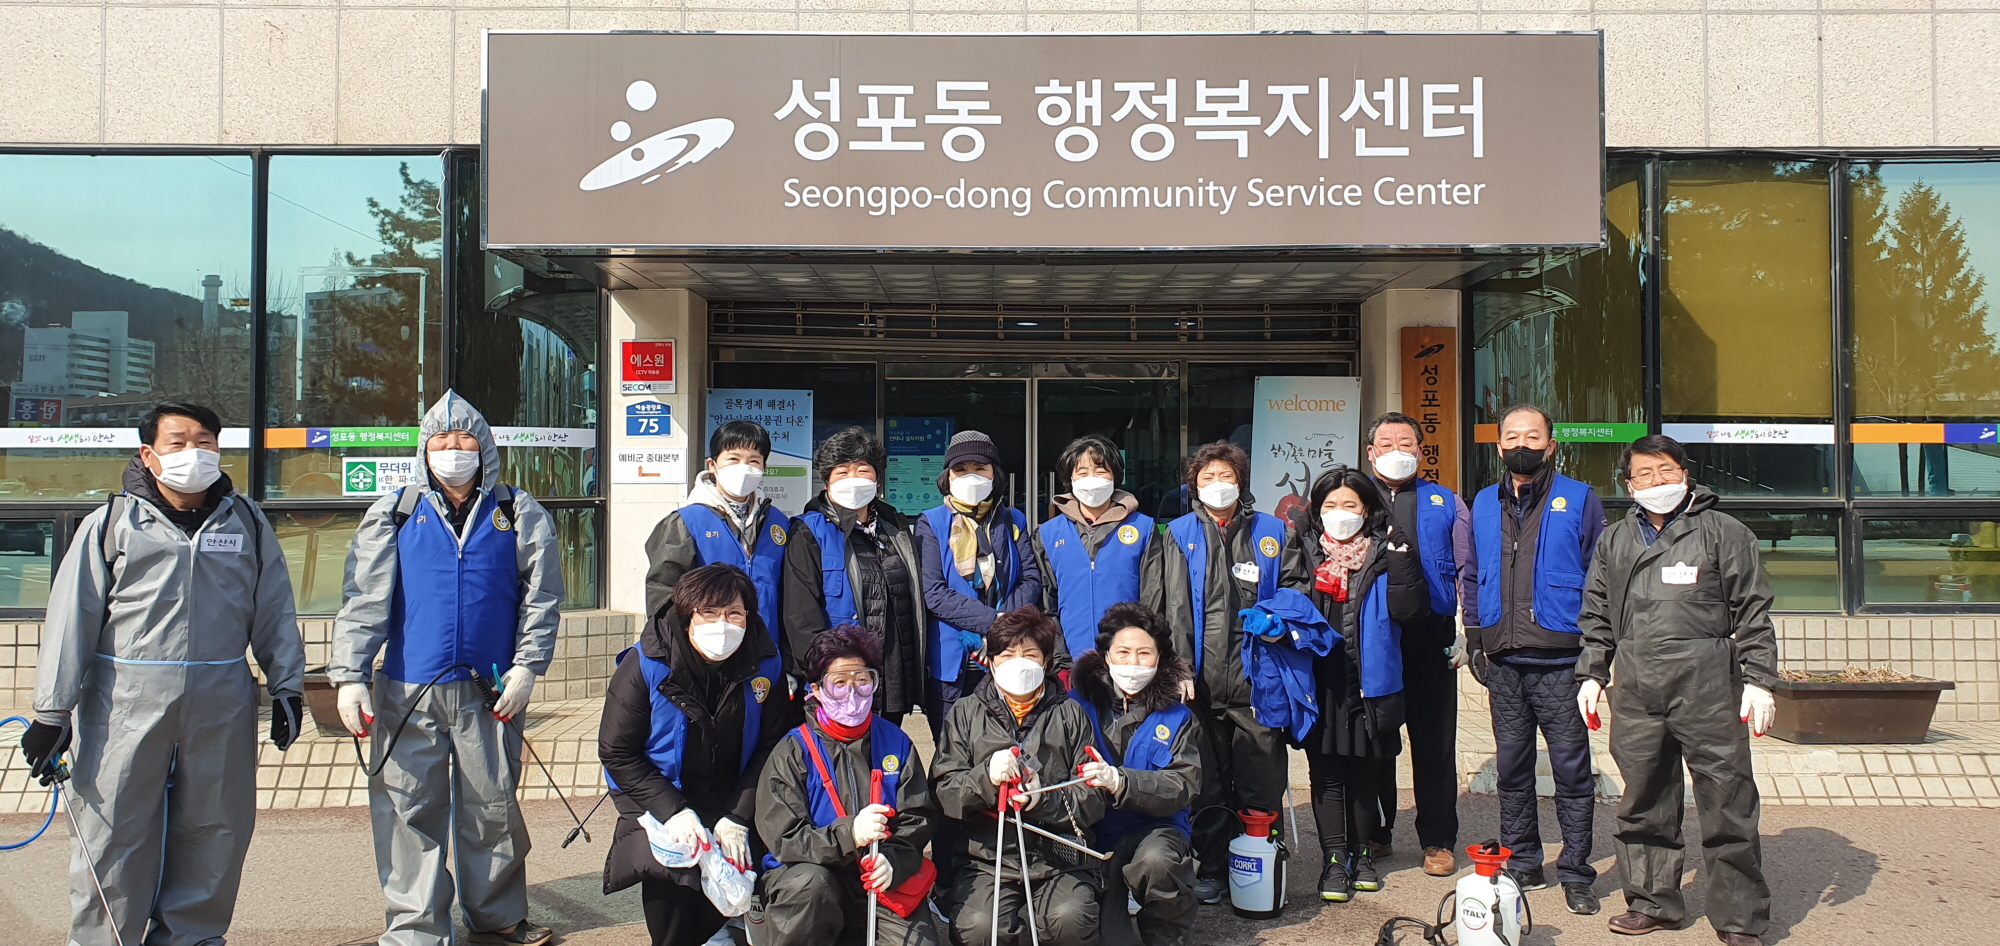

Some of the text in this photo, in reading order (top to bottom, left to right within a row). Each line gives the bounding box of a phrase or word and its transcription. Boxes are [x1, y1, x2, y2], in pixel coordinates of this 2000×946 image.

[774, 77, 1483, 161] 성포동 행정복지센터
[784, 177, 1485, 216] Seongpo-dong Community Service Center
[630, 353, 665, 367] 에스원
[622, 383, 652, 392] SECOM
[724, 399, 797, 411] 골목경제 해결사
[1268, 394, 1346, 412] welcome
[1420, 364, 1441, 434] 성포동
[638, 418, 660, 434] 75
[331, 431, 410, 442] 성포동 행정복지센터
[1561, 427, 1614, 438] 행정복지센터
[618, 453, 680, 463] 예비군 중대본부
[378, 462, 411, 474] 무더위
[1421, 444, 1440, 485] 행정
[206, 538, 237, 547] 안산시
[1234, 859, 1258, 872] CORRI
[1462, 908, 1487, 919] ITALY
